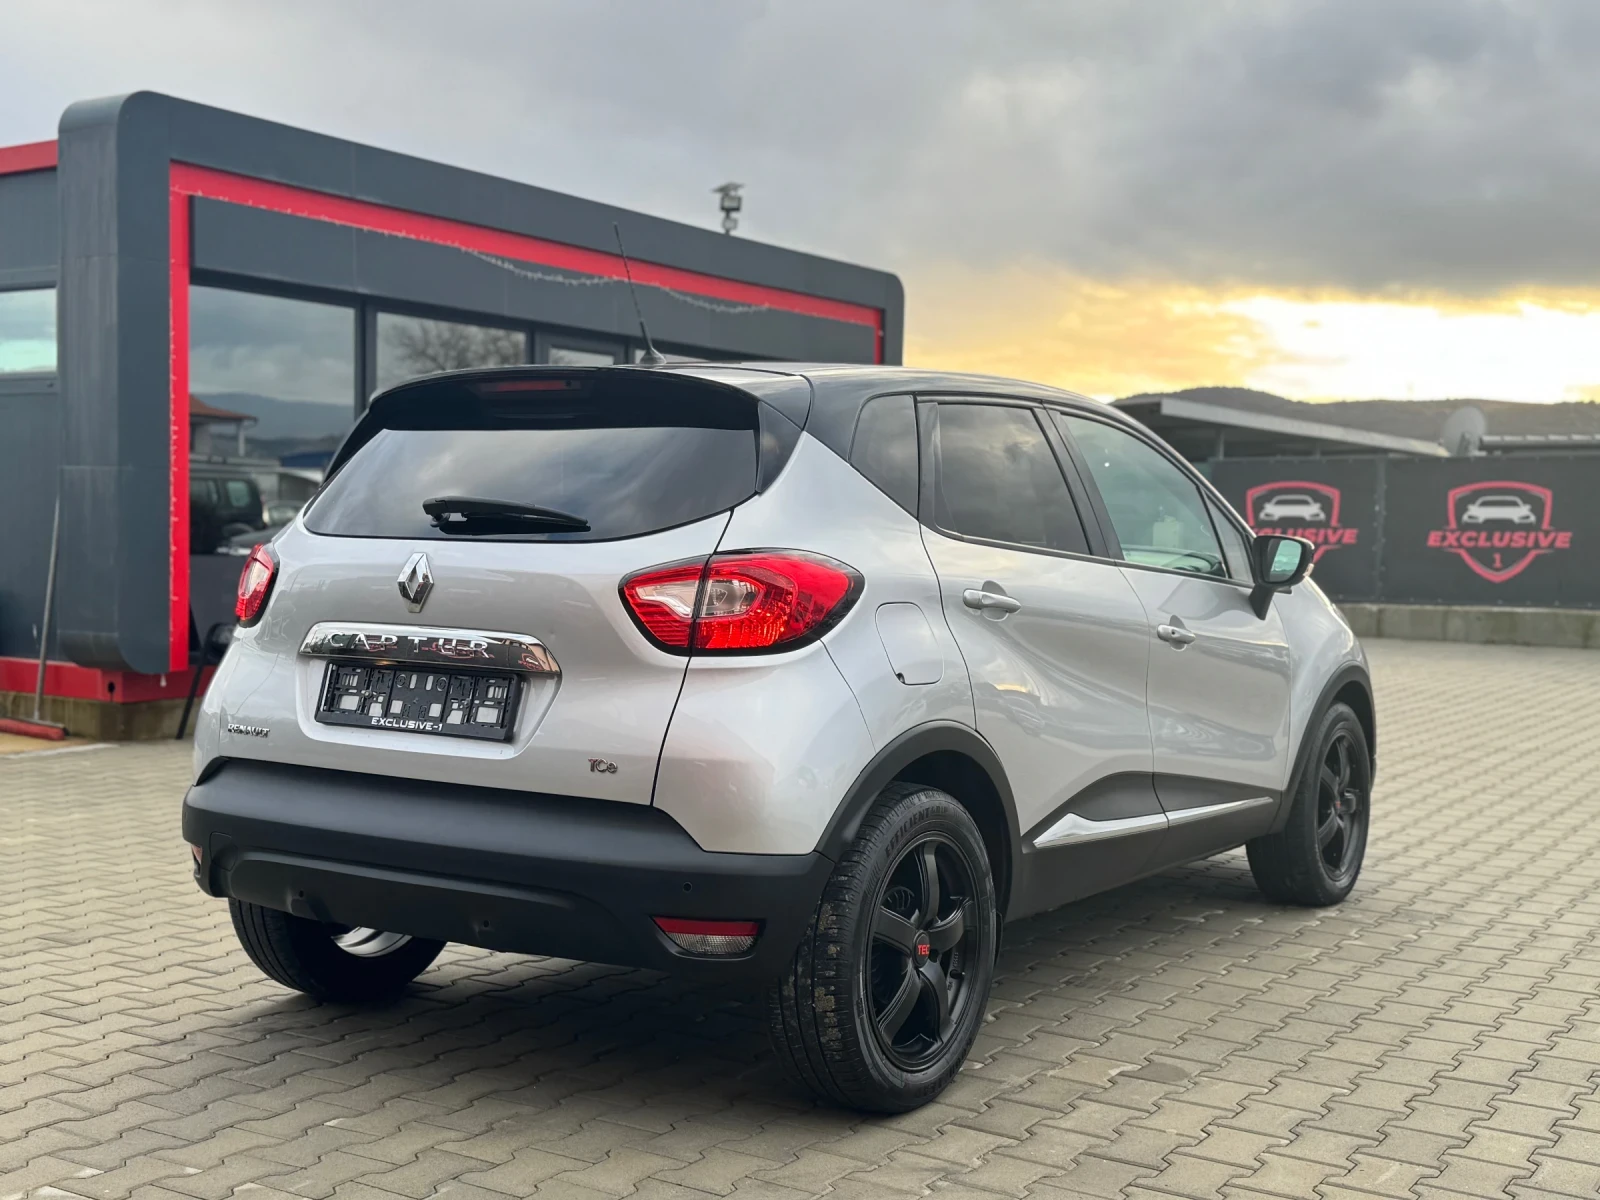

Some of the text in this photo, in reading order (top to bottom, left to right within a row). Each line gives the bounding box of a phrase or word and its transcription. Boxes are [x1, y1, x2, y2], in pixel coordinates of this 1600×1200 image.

[1253, 527, 1358, 545] USIVE
[1426, 530, 1573, 549] EXCLUSIVE
[1492, 552, 1503, 569] 1
[328, 631, 490, 659] CAPTUR
[227, 723, 270, 738] RENAULT
[371, 716, 443, 732] EXCLUSIVE-1
[588, 757, 618, 774] TCe
